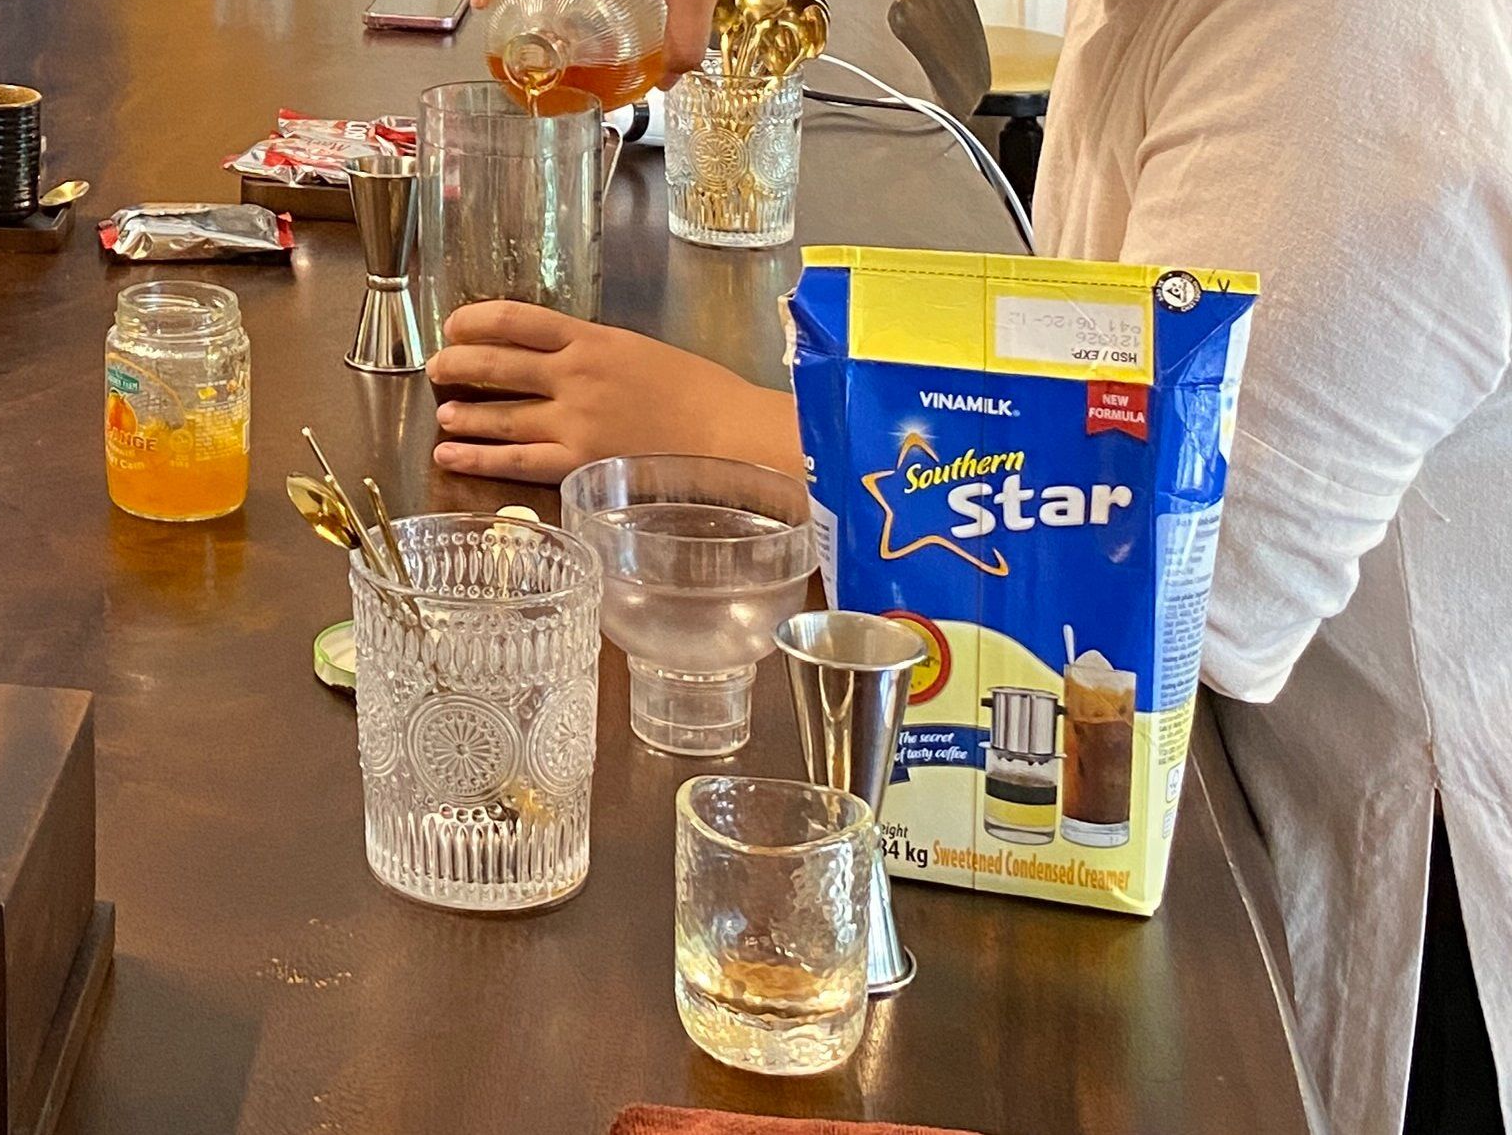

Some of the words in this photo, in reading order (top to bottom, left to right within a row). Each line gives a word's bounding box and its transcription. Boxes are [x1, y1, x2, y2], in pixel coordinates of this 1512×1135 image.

[1111, 351, 1138, 364] HSD
[919, 391, 1013, 416] VINAMILK
[1101, 393, 1129, 408] NEW
[1088, 407, 1146, 424] FORMULA
[106, 425, 157, 452] ANGE
[904, 448, 1025, 494] Southern
[947, 474, 1133, 539] Star
[898, 731, 918, 745] The
[920, 732, 955, 745] secret
[906, 747, 934, 763] tasty
[935, 745, 968, 763] coffee
[881, 821, 909, 840] eight
[905, 840, 928, 869] kg
[932, 839, 1002, 877] Sweetened
[1005, 850, 1075, 886] Condensed
[1077, 860, 1130, 892] Creamer
